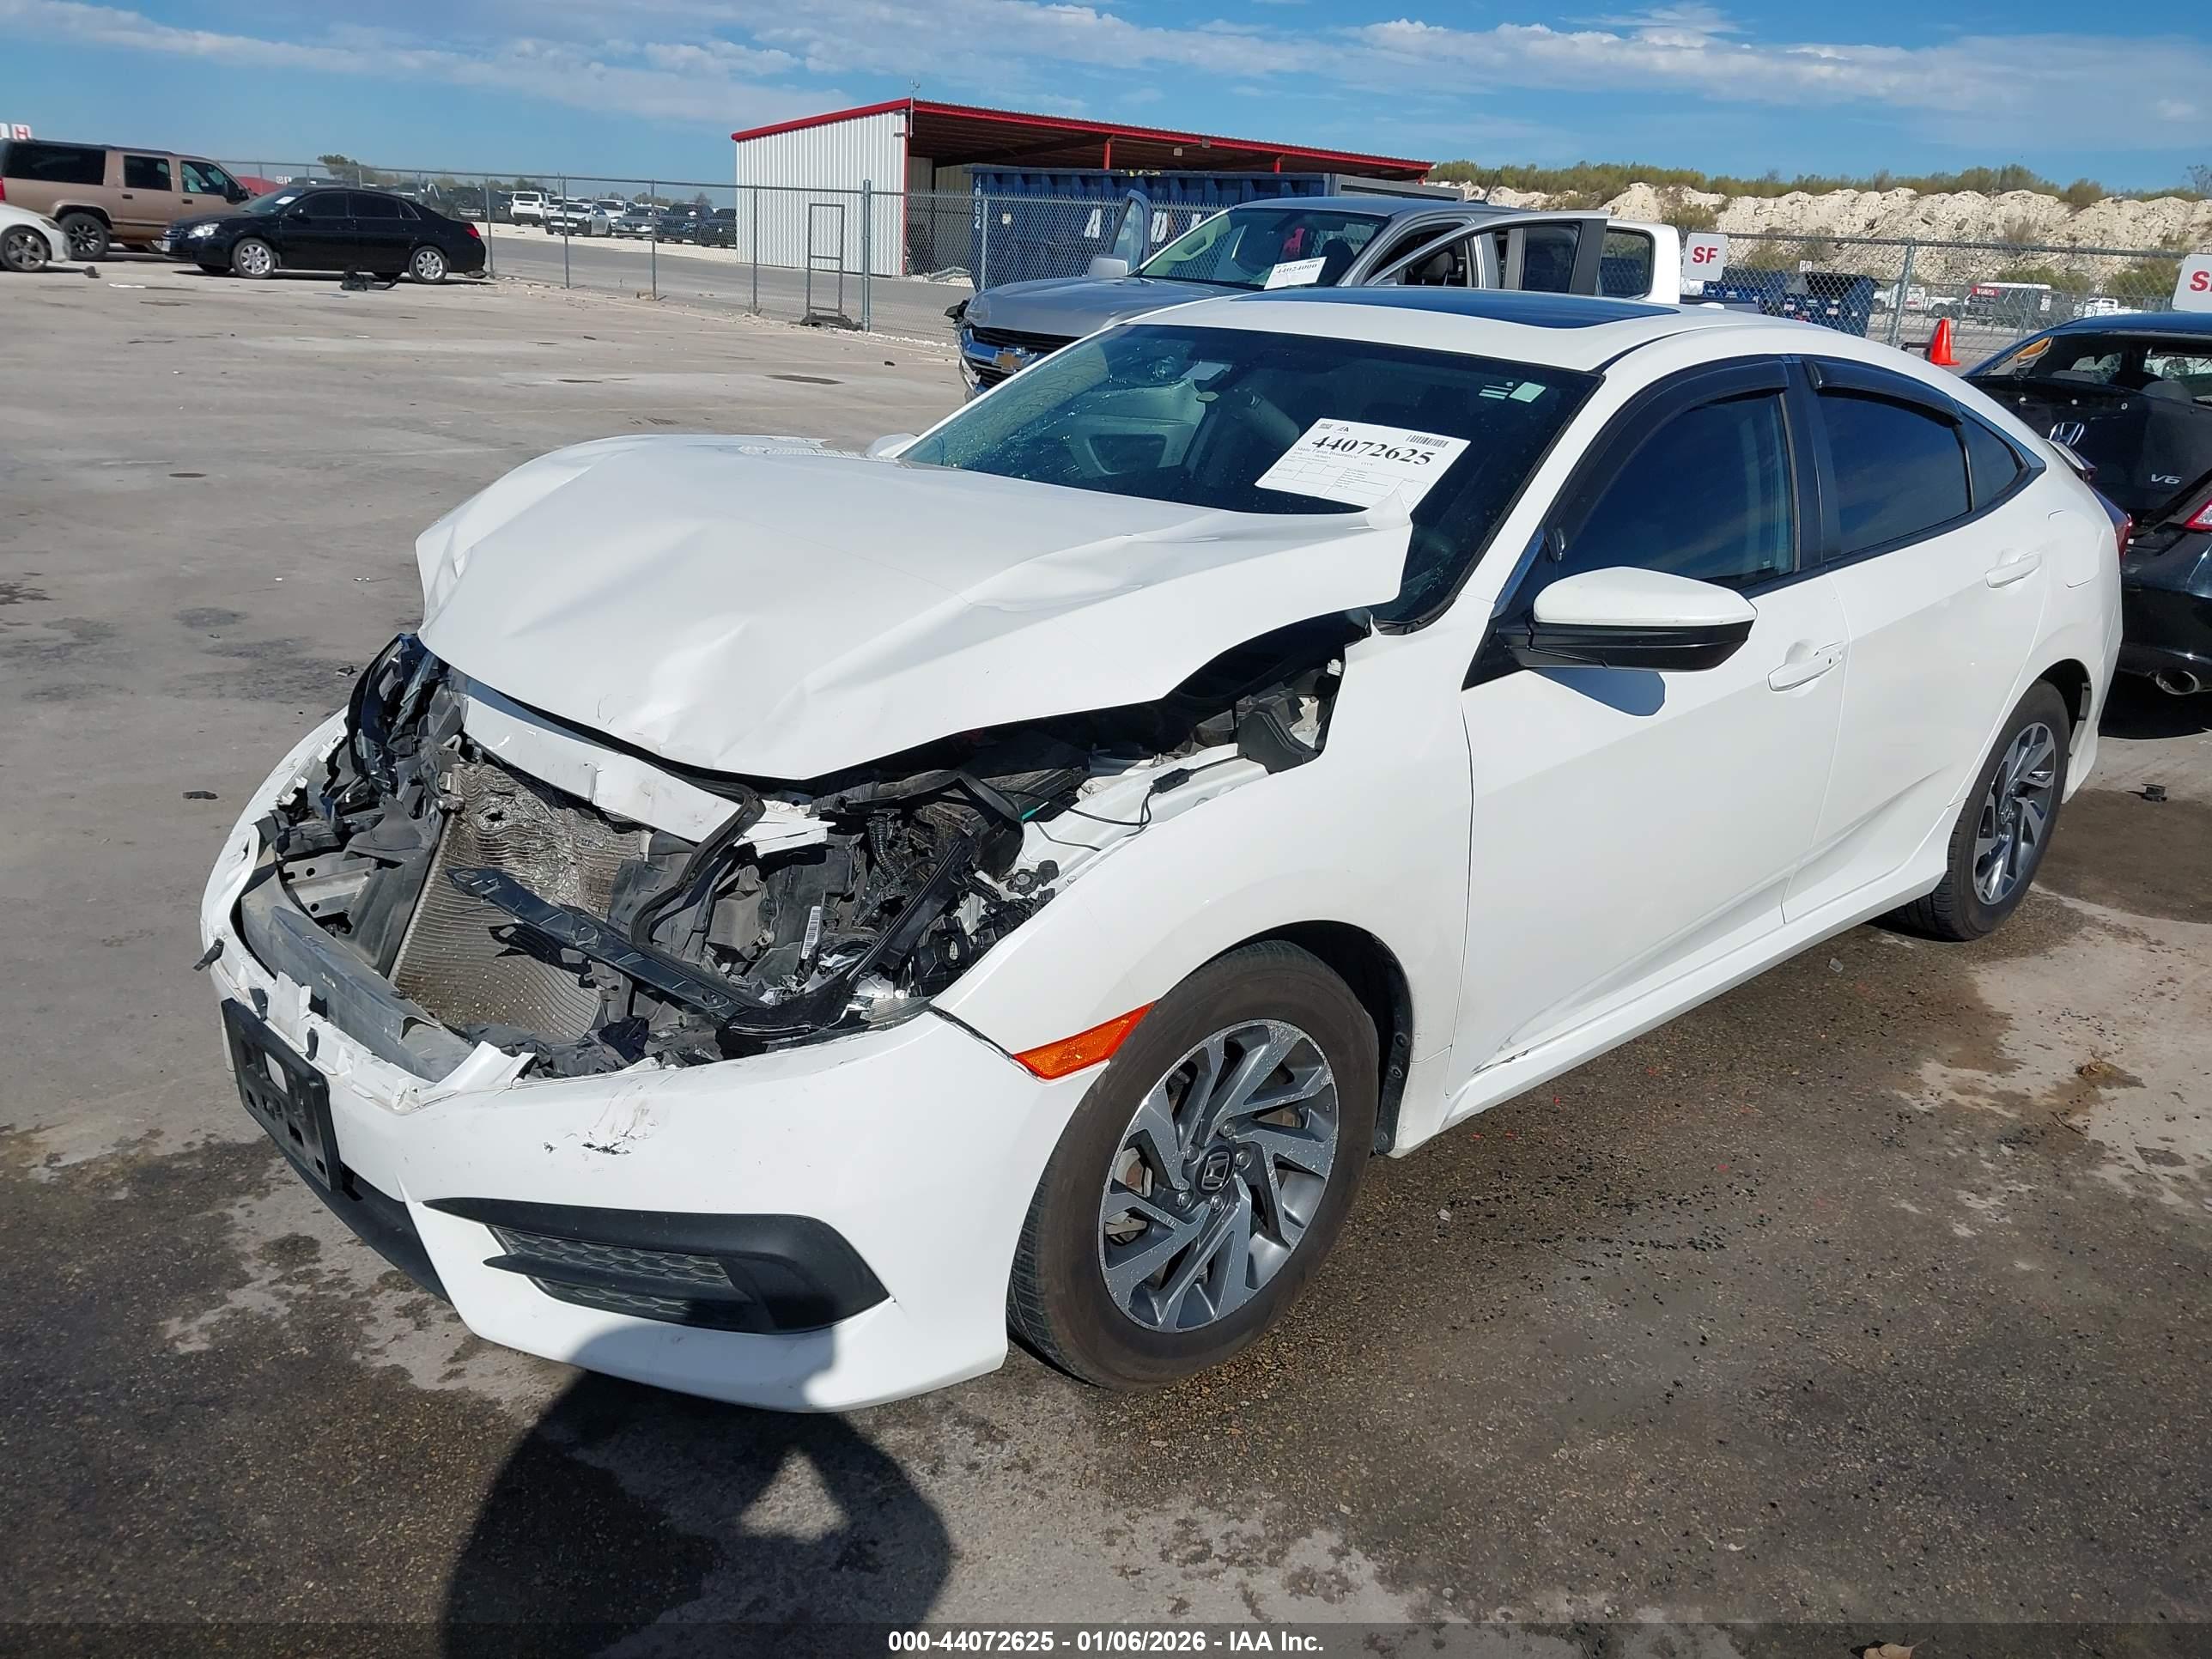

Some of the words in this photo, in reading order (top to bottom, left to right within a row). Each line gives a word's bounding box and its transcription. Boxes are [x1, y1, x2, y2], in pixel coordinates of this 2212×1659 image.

[1692, 246, 1718, 264] SF
[2190, 270, 2212, 292] S
[1312, 435, 1436, 465] 44072625
[2151, 474, 2182, 484] V6
